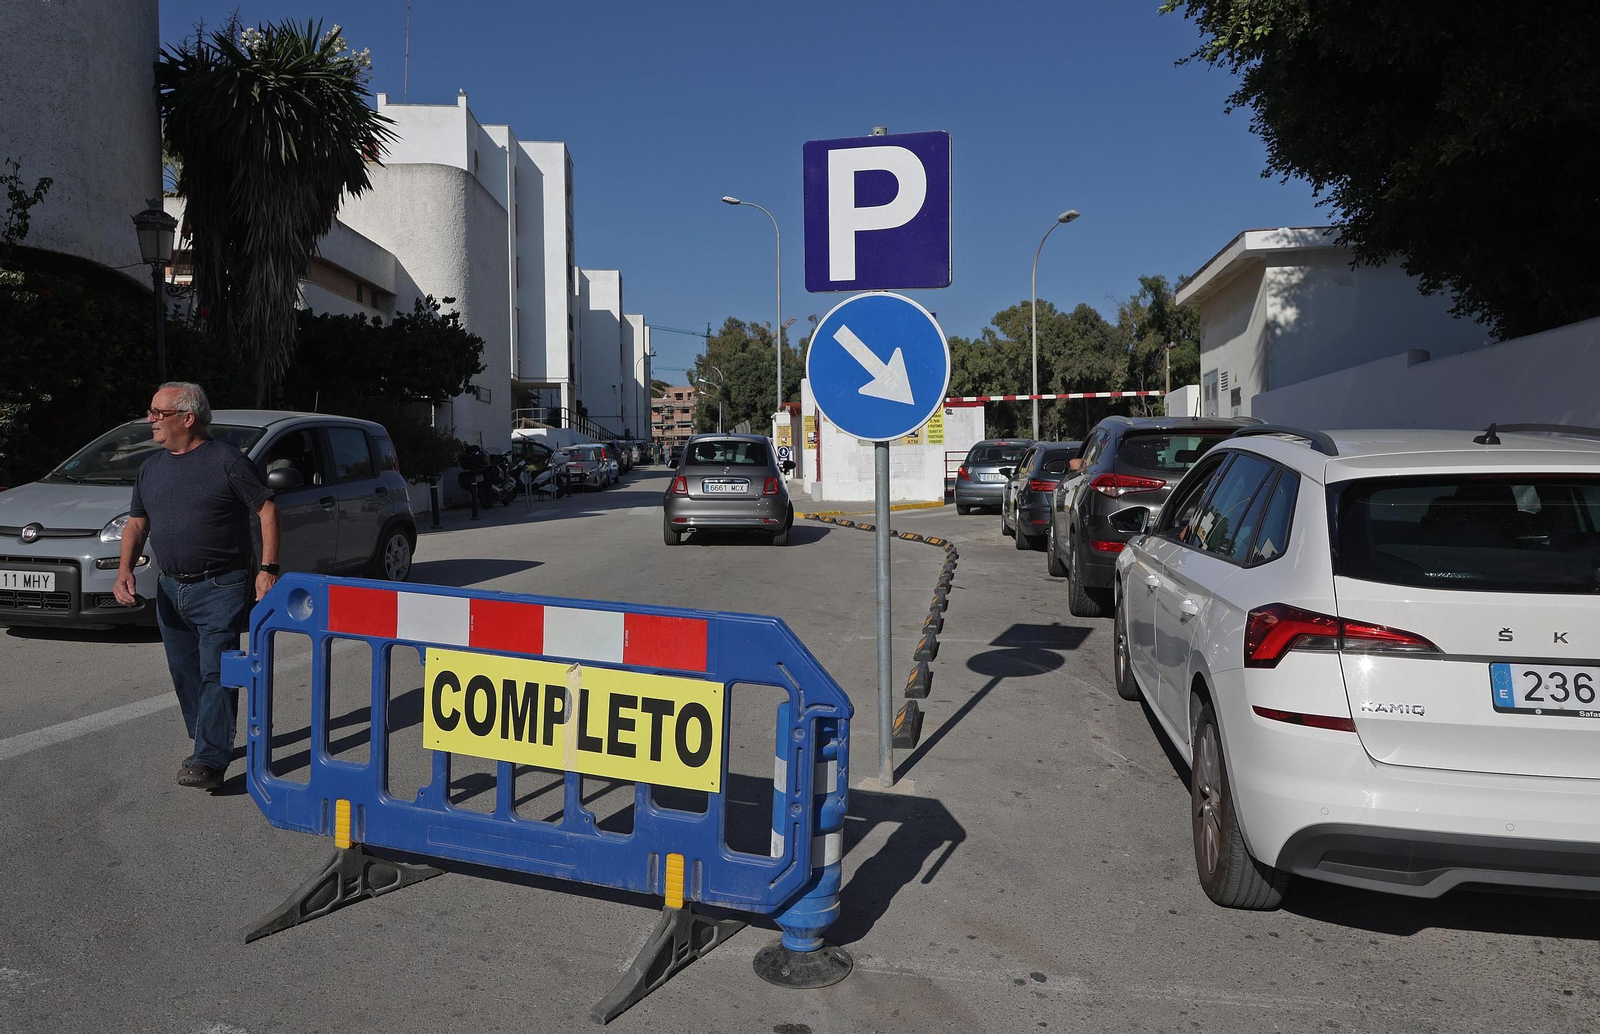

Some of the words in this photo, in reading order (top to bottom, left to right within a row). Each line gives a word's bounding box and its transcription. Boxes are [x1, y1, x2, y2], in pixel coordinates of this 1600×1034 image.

[827, 145, 928, 282] P
[24, 574, 50, 588] MHY
[1499, 689, 1508, 698] E
[1522, 670, 1596, 704] 236
[431, 669, 714, 768] COMPLETO
[1360, 701, 1426, 716] KAMIQ
